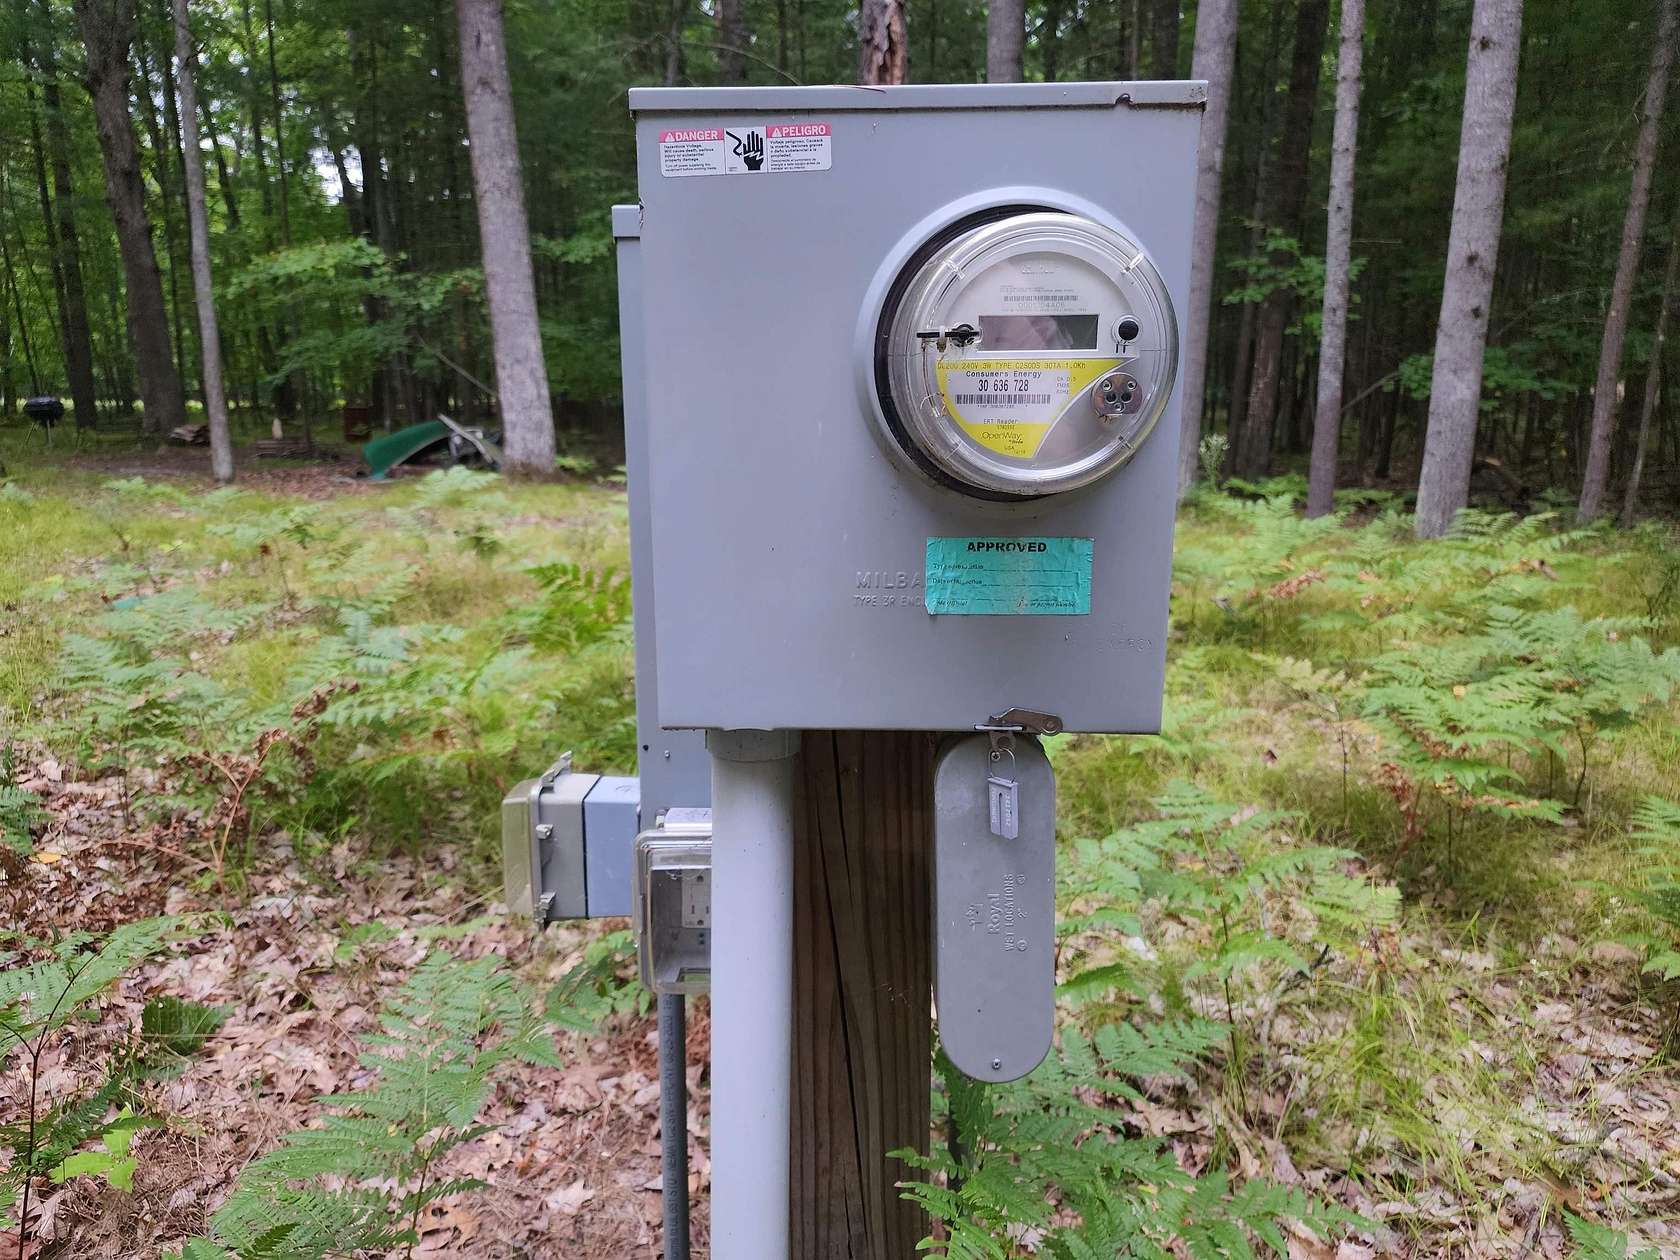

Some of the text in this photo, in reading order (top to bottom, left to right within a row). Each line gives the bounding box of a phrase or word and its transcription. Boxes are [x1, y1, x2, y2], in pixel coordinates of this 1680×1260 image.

[675, 130, 718, 141] DANGER
[782, 125, 826, 136] PELIGRO
[1013, 371, 1042, 379] Energy
[978, 379, 1029, 392] 30 636 728
[967, 542, 1047, 553] APPROVED
[855, 571, 923, 589] MILBA
[986, 893, 1003, 935] Royal
